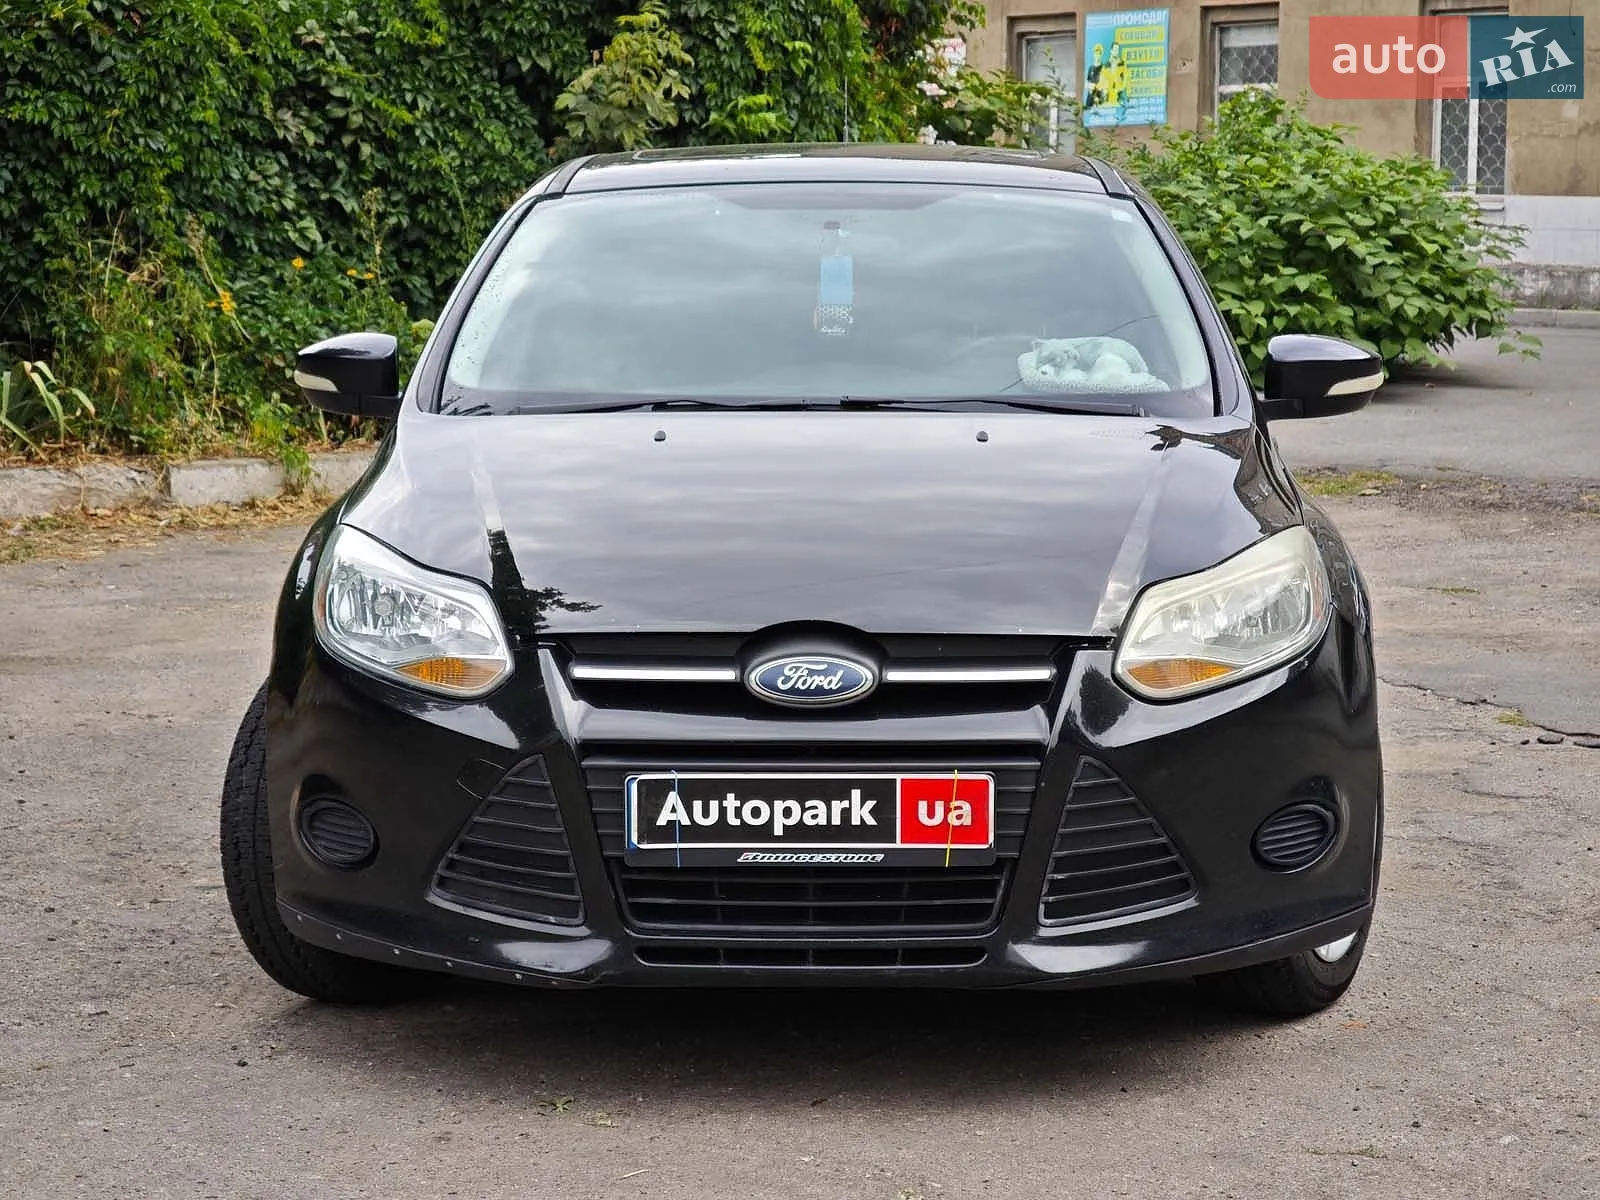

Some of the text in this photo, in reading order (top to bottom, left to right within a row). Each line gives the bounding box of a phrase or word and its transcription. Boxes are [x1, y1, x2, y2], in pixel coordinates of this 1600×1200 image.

[777, 662, 844, 691] Ford
[656, 789, 972, 836] Autopark ua
